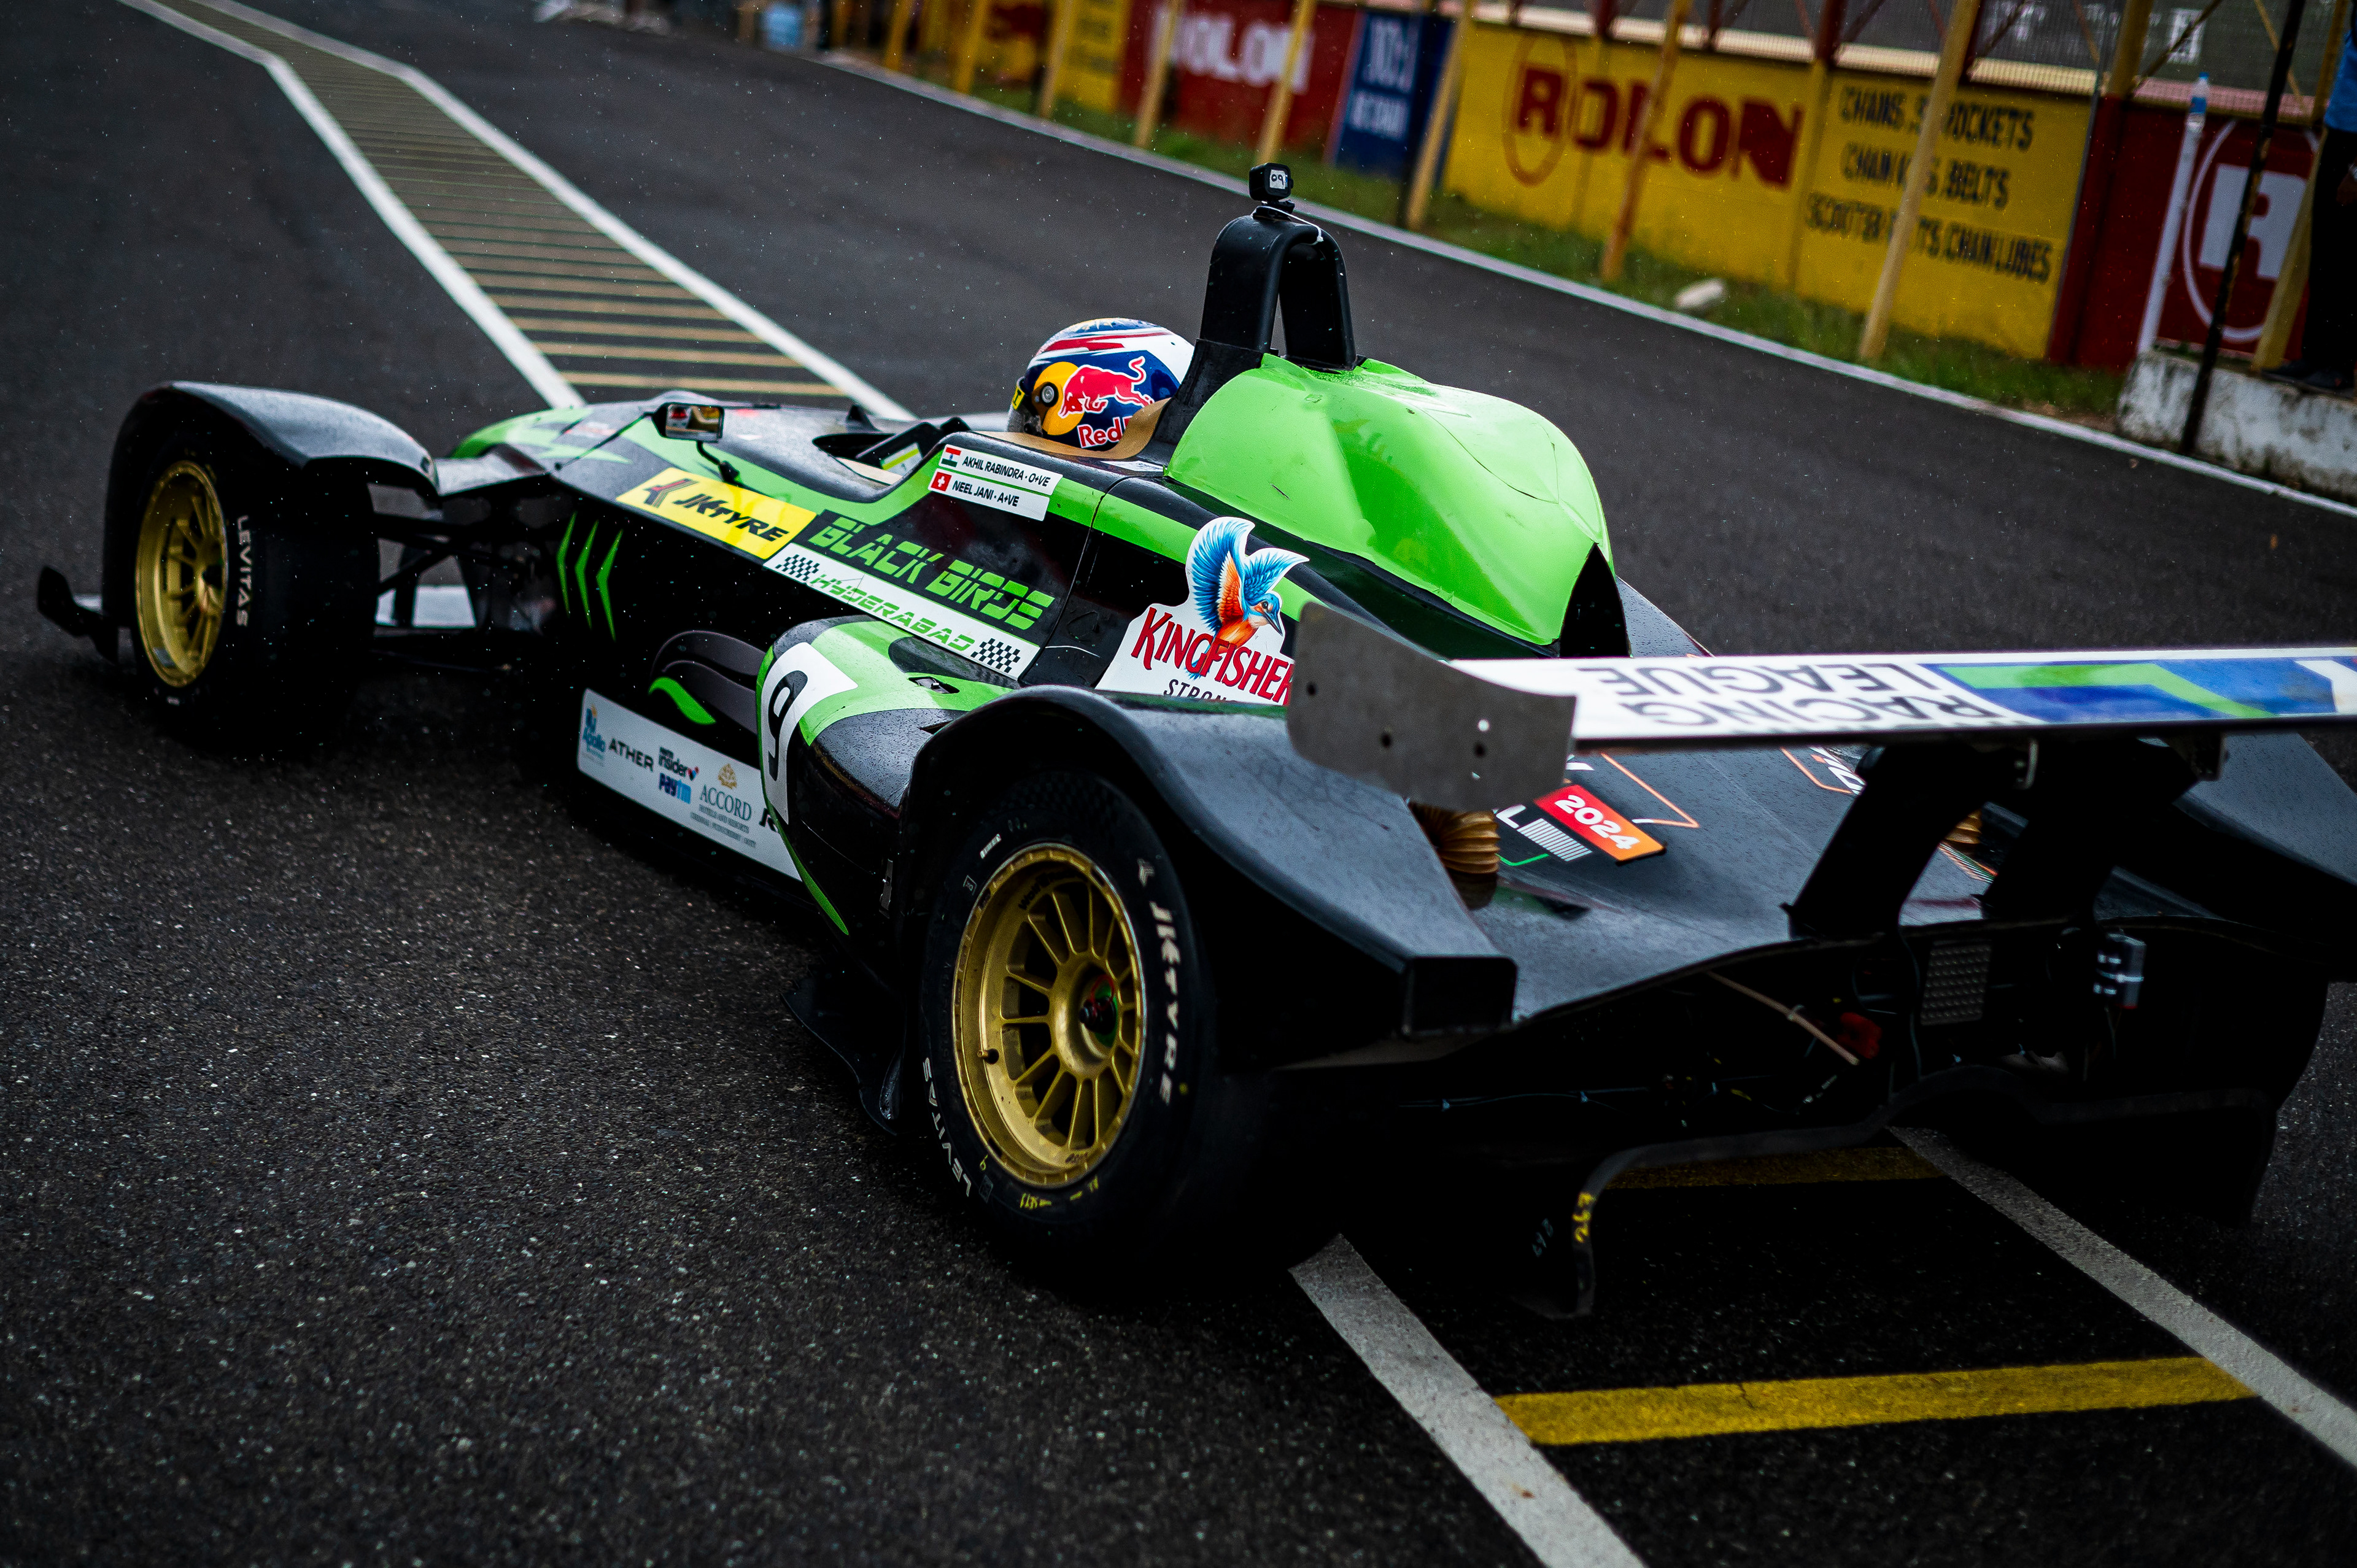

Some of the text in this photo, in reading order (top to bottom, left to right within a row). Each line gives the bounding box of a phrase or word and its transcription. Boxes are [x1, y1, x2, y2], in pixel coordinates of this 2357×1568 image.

[962, 455, 1051, 487] AKHIL RABINDRA O+VE
[952, 480, 1020, 507] NEEL JANI A+VE
[237, 516, 252, 626] LEVITAS
[808, 516, 1056, 630] BLACK BIRDS
[809, 573, 976, 652] HYDERABAD
[1577, 663, 1941, 697] LEAGUE
[1619, 695, 2004, 727] RACING
[608, 738, 654, 772] ATHER
[699, 784, 752, 821] ACCORD
[1554, 794, 1641, 850] 2024
[923, 1056, 972, 1197] LEVITAS
